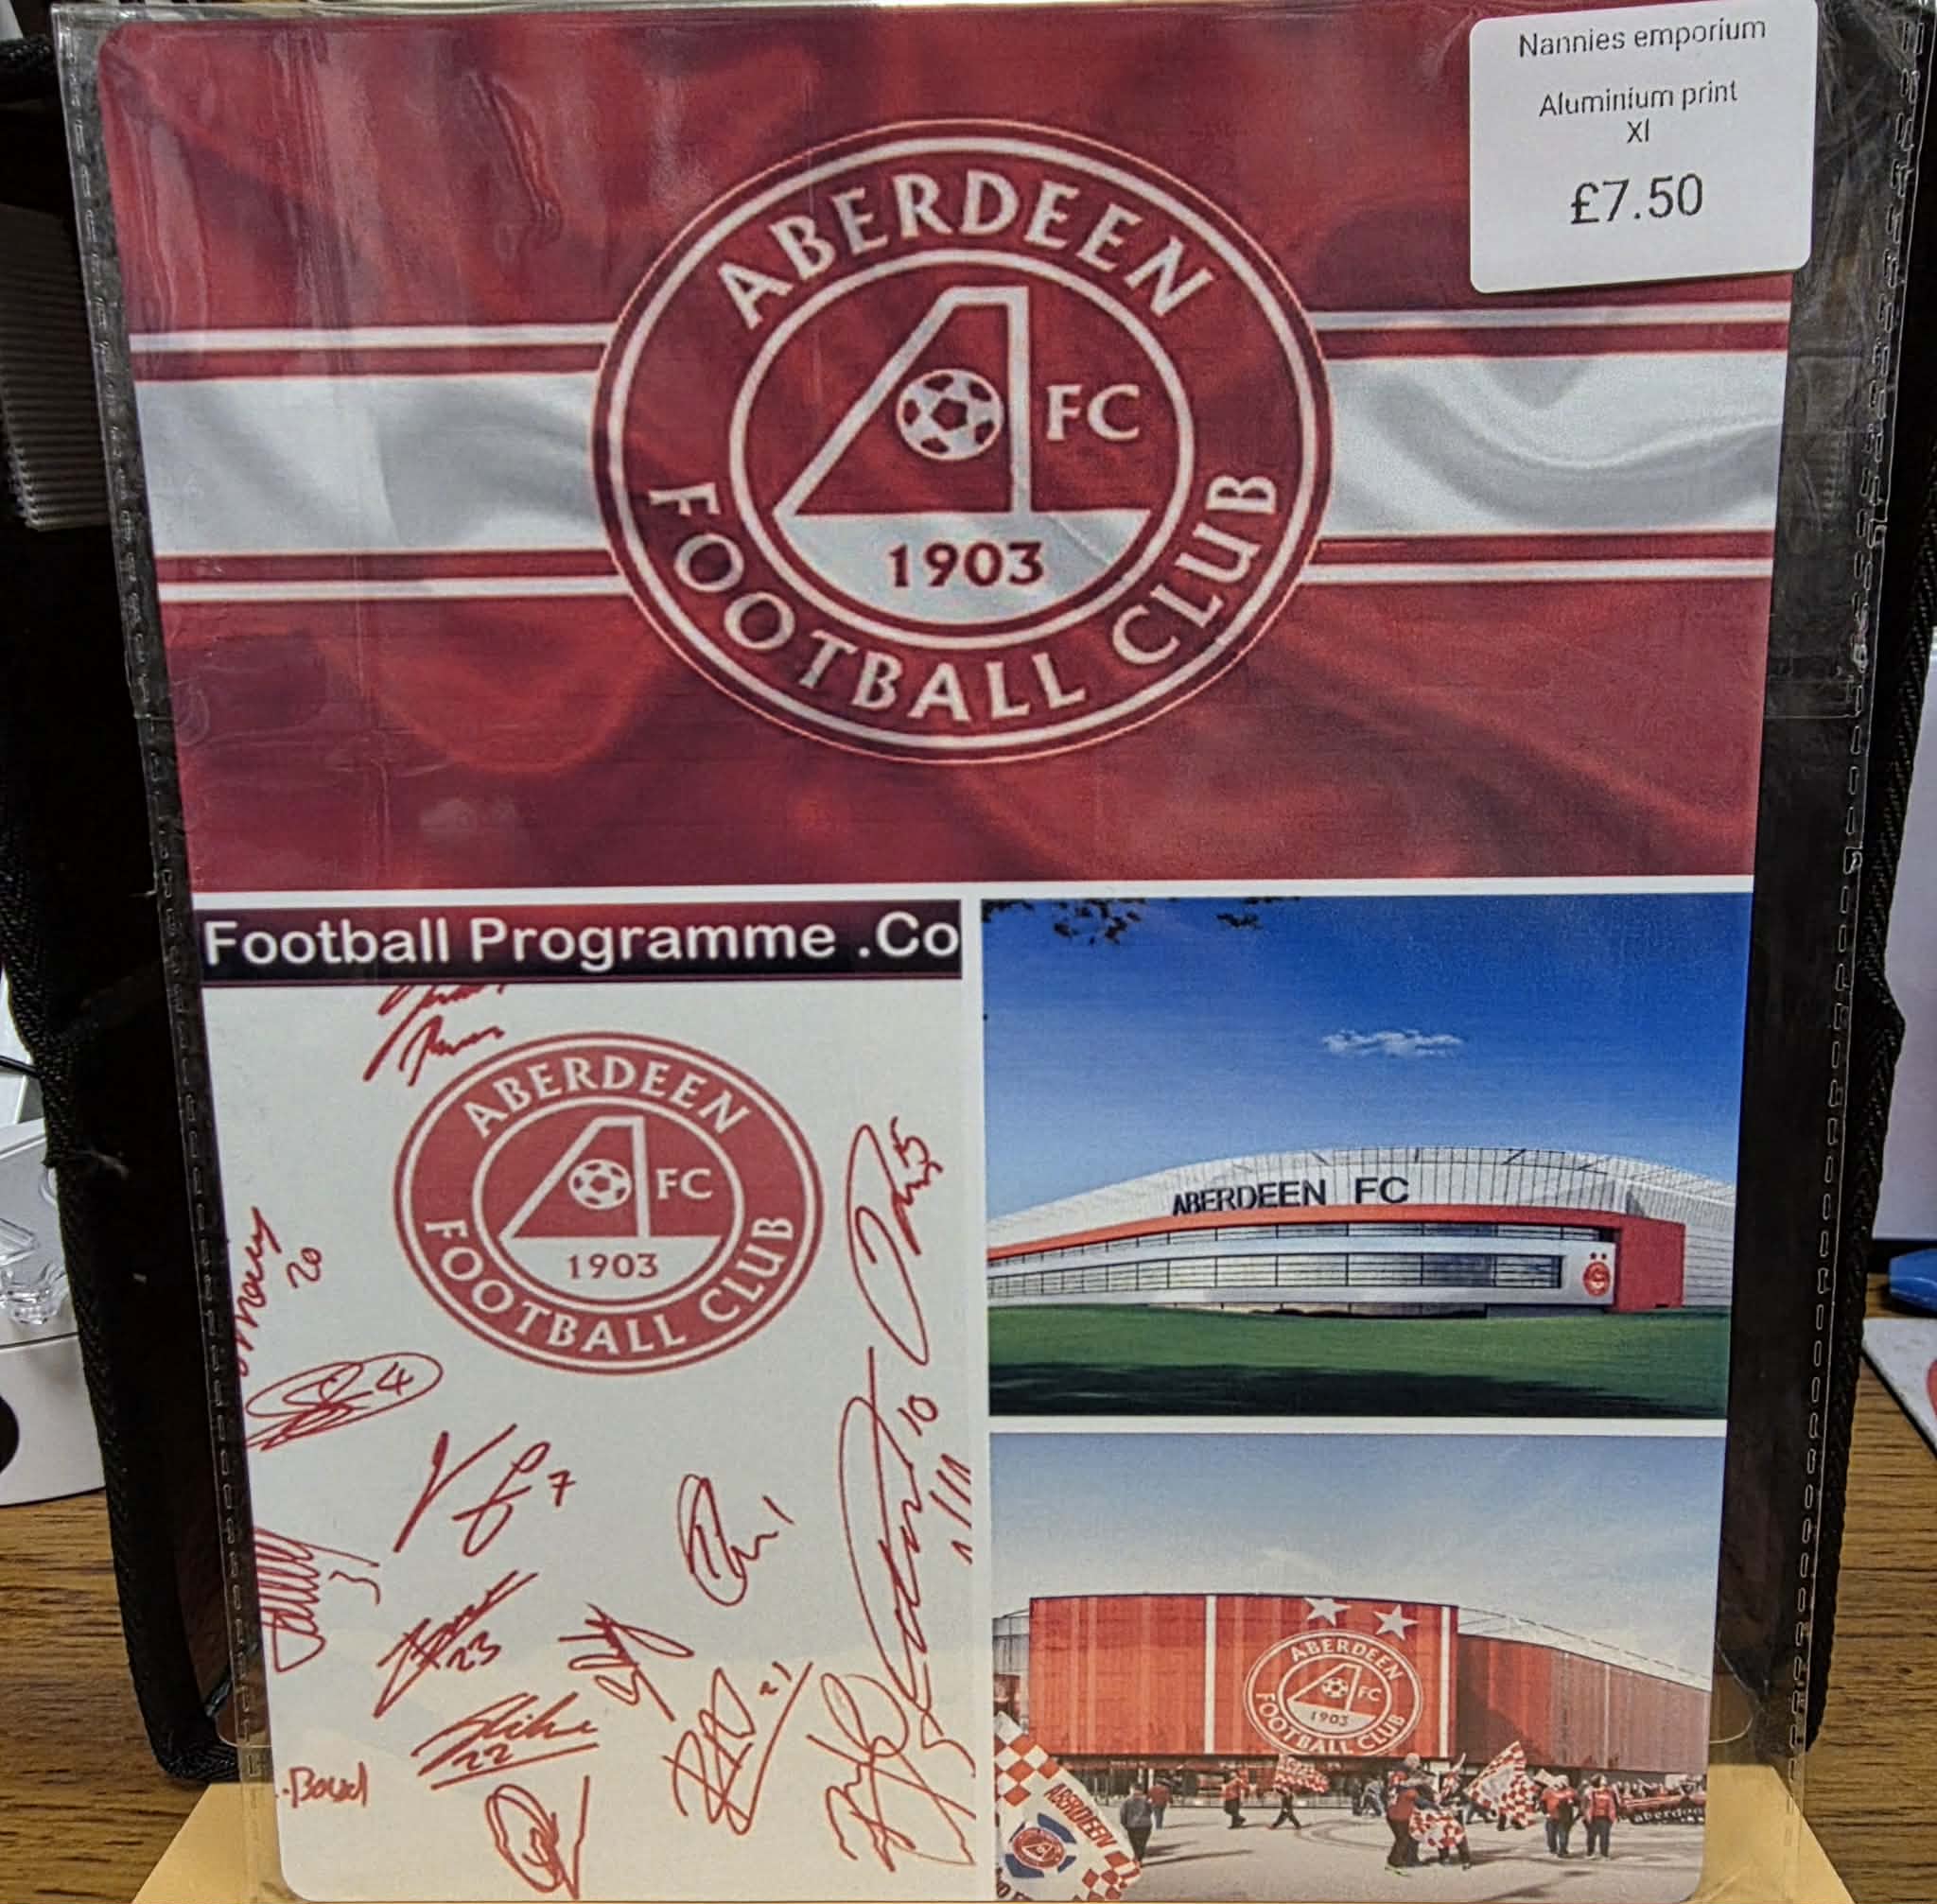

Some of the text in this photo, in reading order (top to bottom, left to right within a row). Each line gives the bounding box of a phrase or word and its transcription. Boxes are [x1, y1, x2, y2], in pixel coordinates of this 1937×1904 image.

[1519, 17, 1767, 58] Nannies emporium
[1539, 79, 1738, 117] Aluminium print
[1570, 173, 1704, 224] £7.50
[716, 169, 1214, 329] ABERDEEN
[1046, 383, 1142, 442] FC
[889, 542, 1045, 588] 1903
[648, 473, 1278, 723] FOOTBALL CLUB
[203, 918, 449, 967] Football
[470, 921, 836, 977] Programme
[463, 1056, 751, 1139] ABERDEEN
[657, 1166, 713, 1200] FC
[1173, 1176, 1409, 1216] ABERDEEN FC
[425, 1219, 688, 1356] FOOTBALL
[700, 1215, 794, 1321] CLUB
[567, 1251, 660, 1280] 1903
[1288, 1638, 1405, 1682] ABERDEEN
[1357, 1685, 1383, 1703] FC
[1255, 1691, 1406, 1755] FOOTBALL CLUB
[1310, 1710, 1349, 1727] 1903
[1043, 1782, 1119, 1849] ABERDEEN
